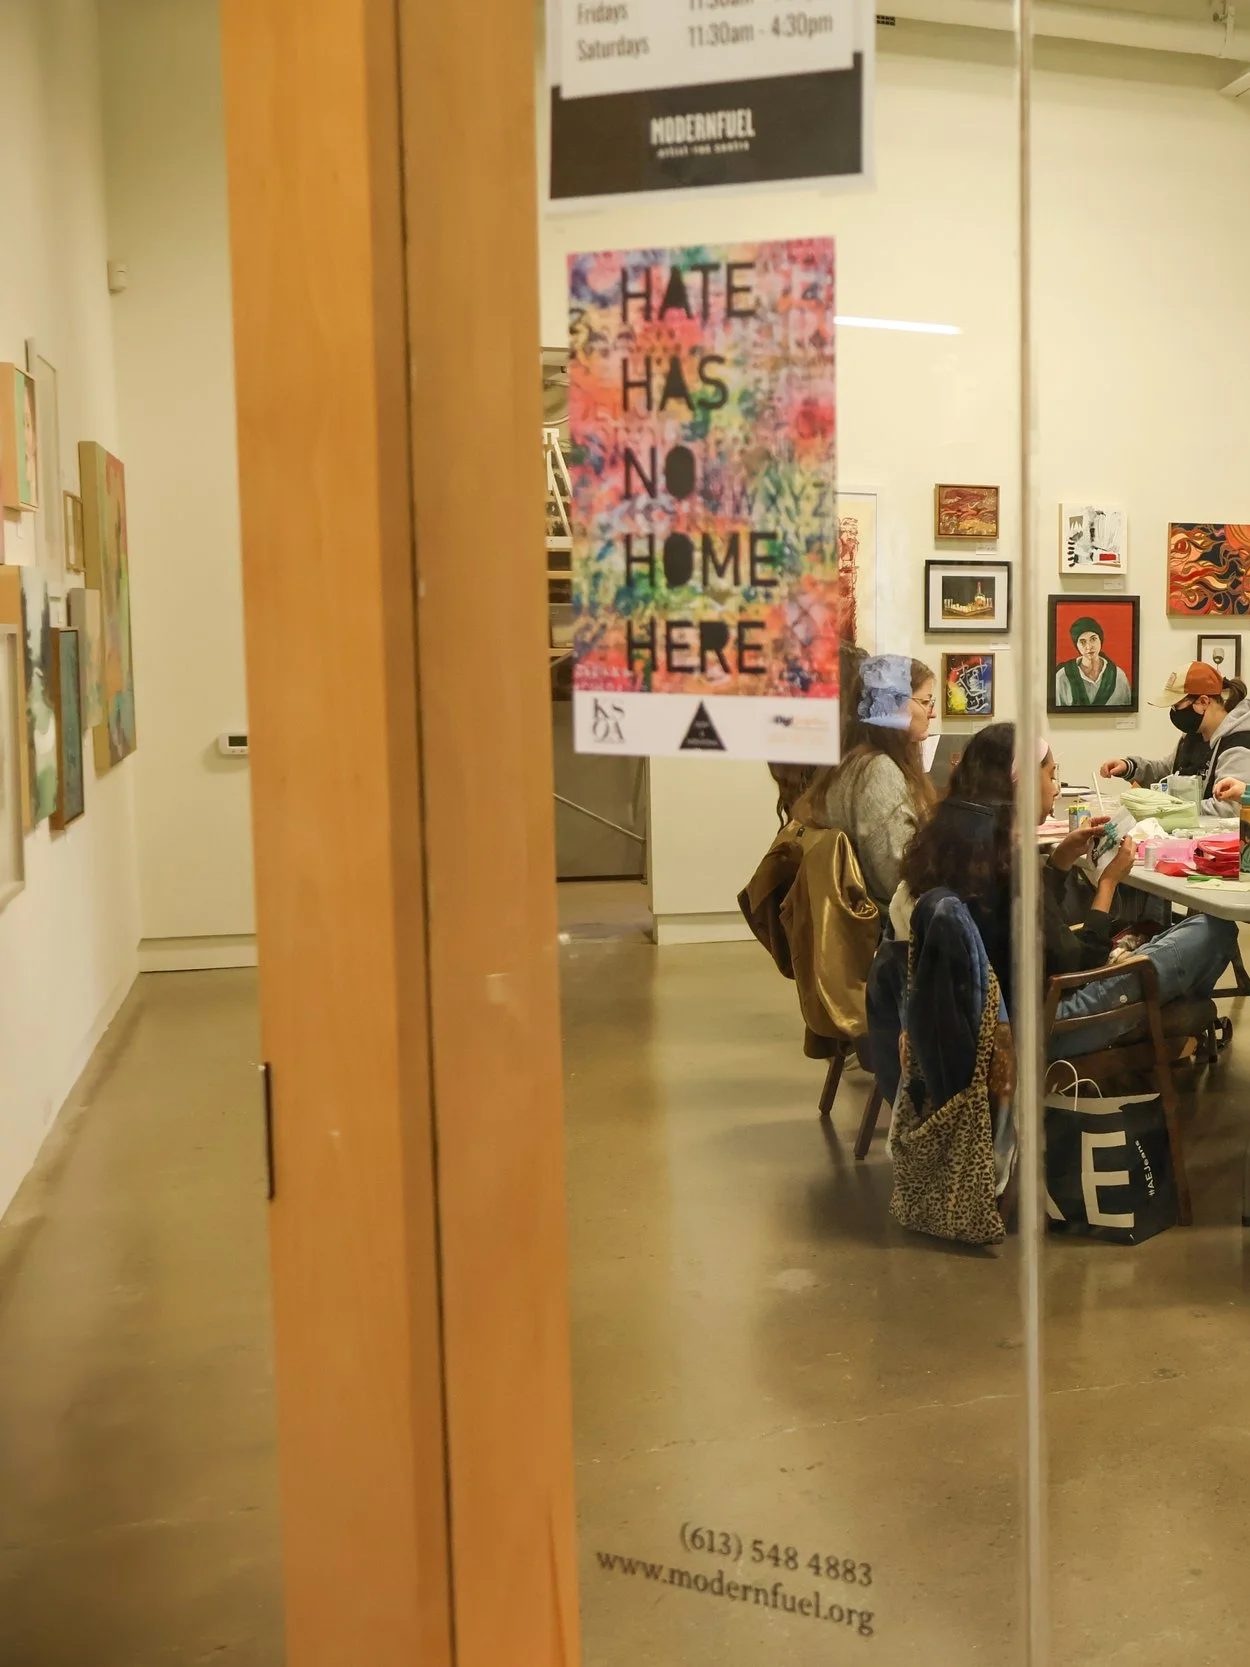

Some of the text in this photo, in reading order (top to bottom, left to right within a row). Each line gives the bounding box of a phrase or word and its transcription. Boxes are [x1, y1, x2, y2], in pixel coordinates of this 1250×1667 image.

[577, 4, 628, 25] Fridays
[577, 36, 650, 62] Saturdays
[688, 20, 754, 48] 11:30am
[771, 11, 833, 40] 4:30pm
[650, 107, 756, 147] MODERNFUEL
[621, 262, 756, 323] HATE
[622, 354, 729, 412] HAS
[624, 445, 696, 500] NO
[624, 532, 779, 589] HOME
[626, 619, 766, 675] HERE
[680, 1521, 873, 1588] (613) 548 4883
[595, 1550, 875, 1637] www.modernfuel.org
